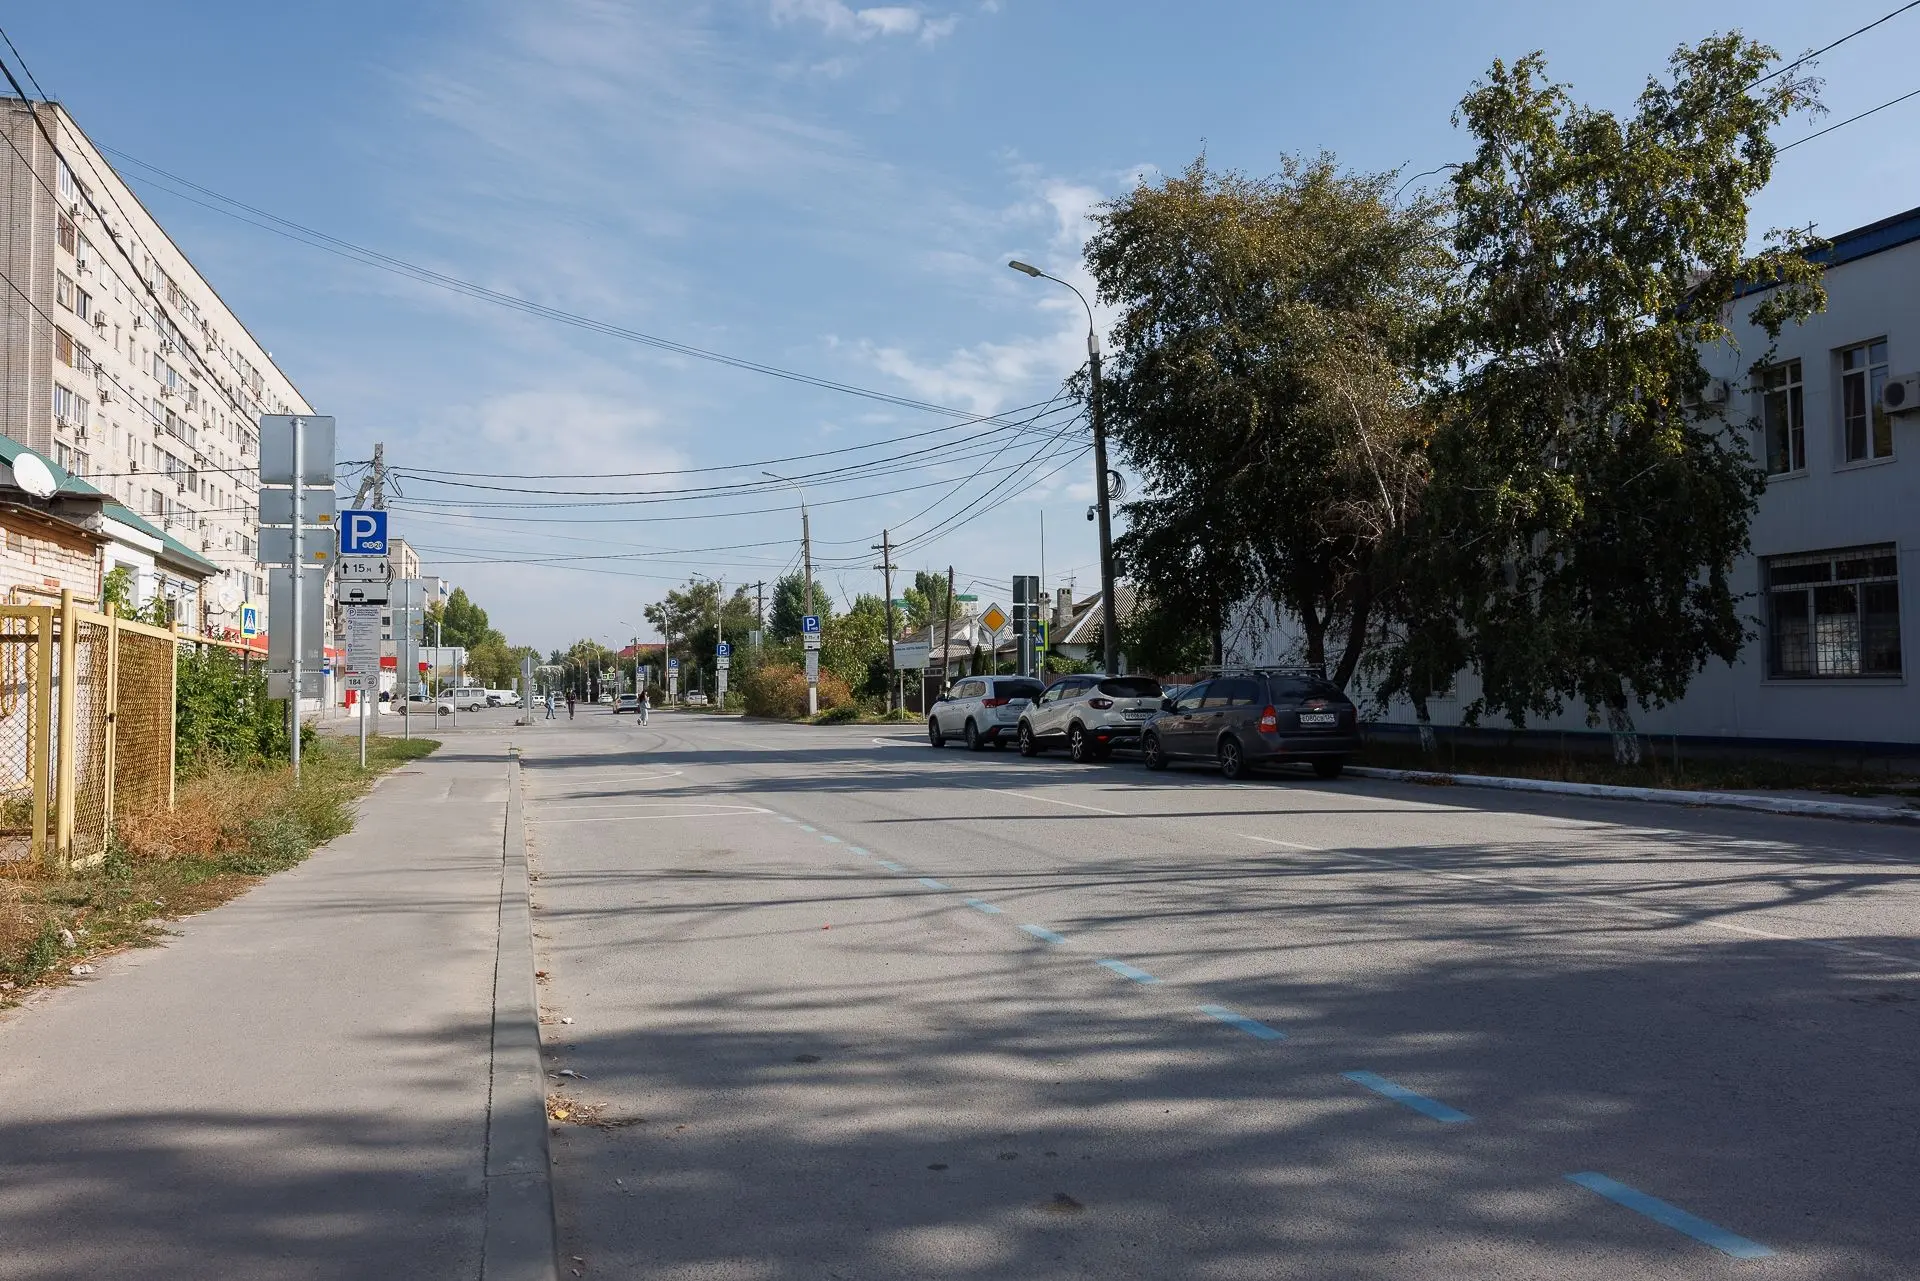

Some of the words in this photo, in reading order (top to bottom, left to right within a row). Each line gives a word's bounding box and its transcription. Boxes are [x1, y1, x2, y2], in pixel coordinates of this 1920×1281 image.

[351, 515, 377, 550] P
[353, 563, 366, 573] 15
[806, 617, 816, 631] P
[719, 645, 726, 655] P
[670, 659, 677, 667] P
[348, 678, 361, 686] 184
